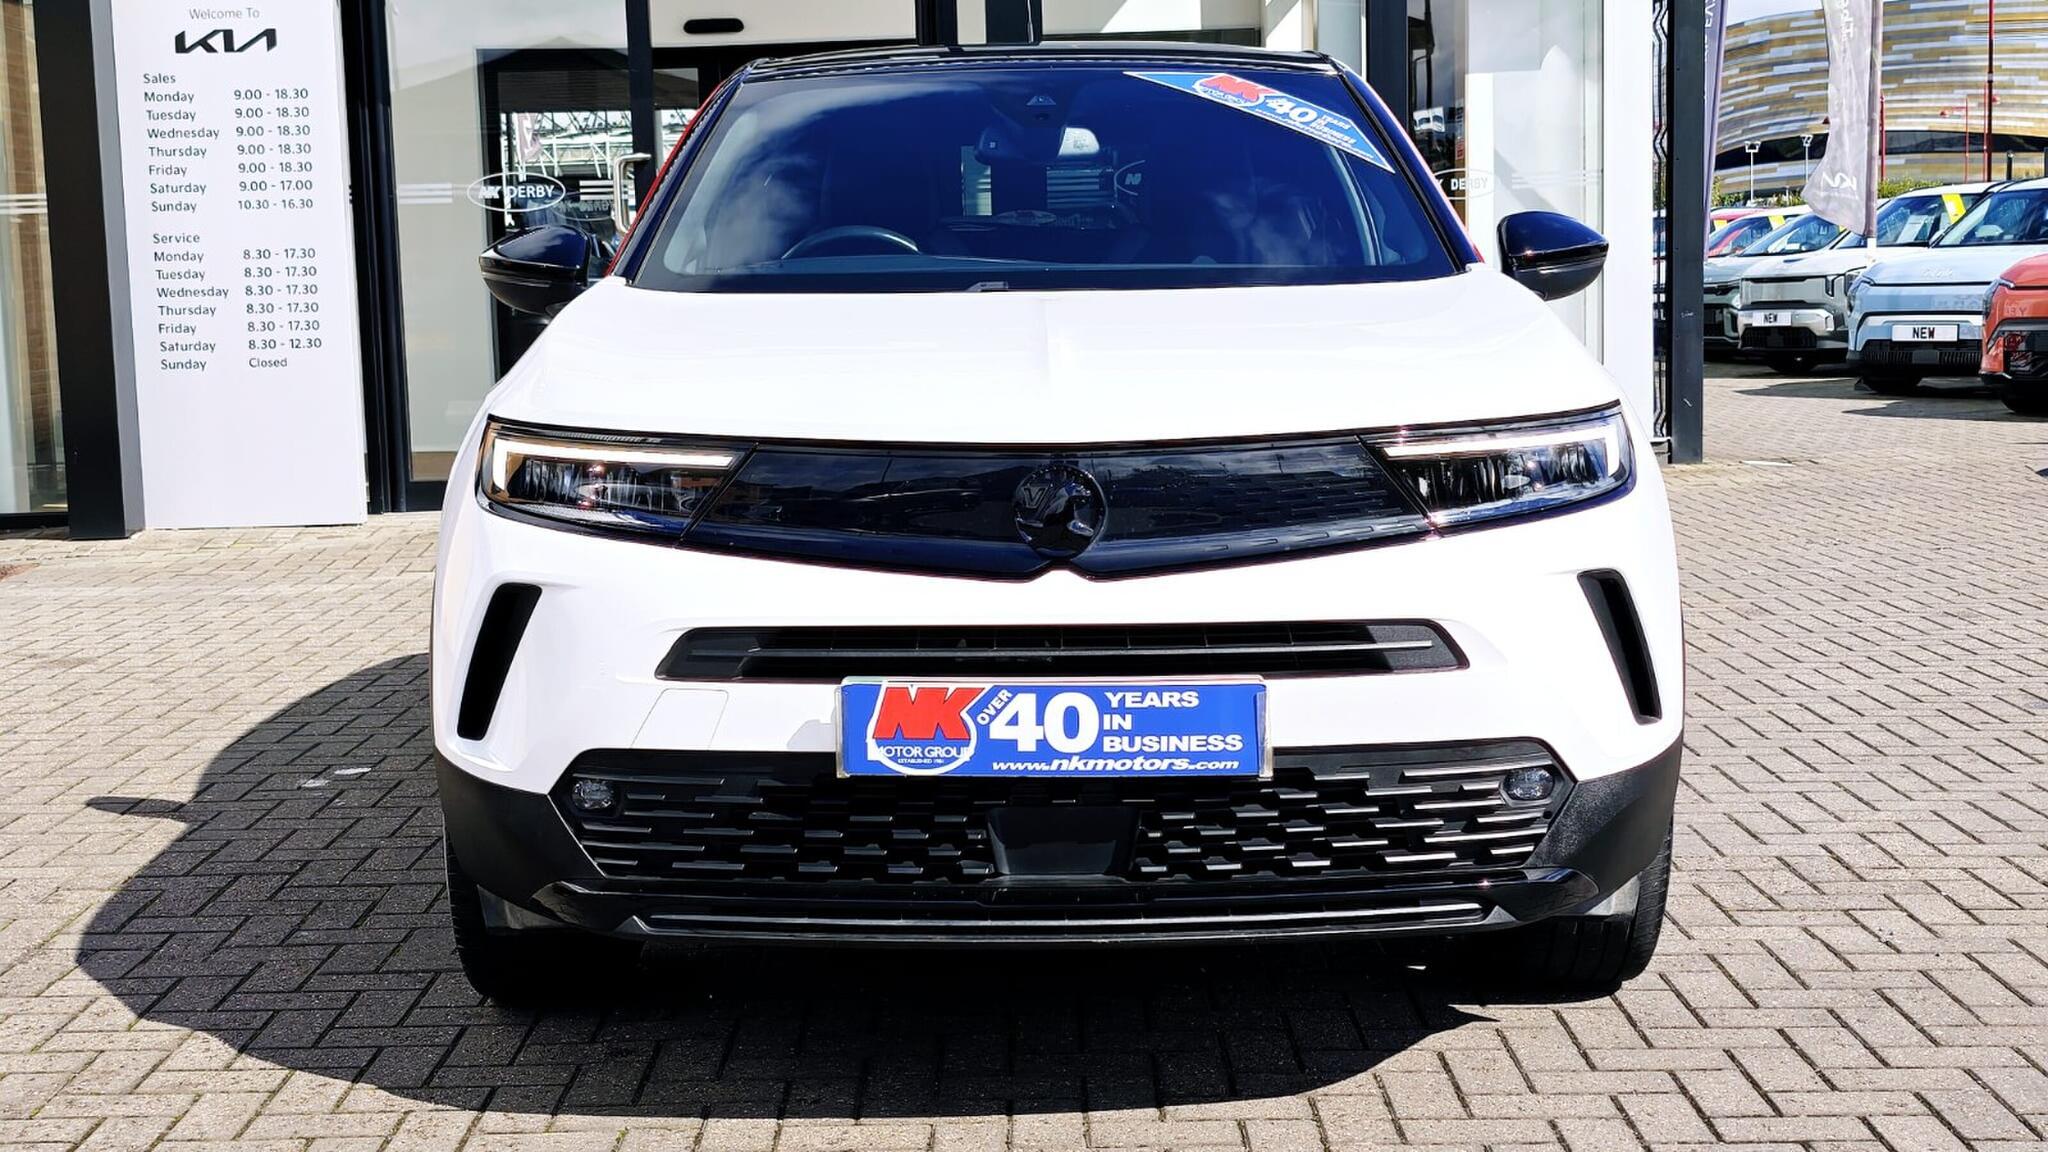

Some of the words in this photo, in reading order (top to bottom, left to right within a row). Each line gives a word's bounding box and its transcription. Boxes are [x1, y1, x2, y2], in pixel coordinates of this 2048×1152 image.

[189, 8, 242, 20] Welcome
[246, 8, 260, 18] To
[175, 28, 277, 54] KIA
[143, 73, 176, 84] Sales
[144, 91, 194, 103] Monday
[234, 89, 262, 100] 9.00
[275, 88, 308, 99] 18.30
[146, 110, 196, 122] Tuesday
[235, 108, 263, 118] 9.00
[276, 107, 309, 117] 18.30
[1266, 98, 1317, 122] 40
[147, 128, 219, 140] Wednesday
[236, 126, 264, 137] 9.00
[277, 125, 310, 136] 18.30
[148, 146, 207, 158] Thursday
[237, 144, 265, 155] 9.00
[278, 143, 311, 154] 18.30
[149, 165, 187, 177] Friday
[238, 162, 266, 173] 9.00
[279, 161, 312, 172] 18.30
[150, 183, 206, 195] Saturday
[239, 180, 267, 191] 9.00
[280, 180, 313, 191] 17.00
[478, 186, 502, 199] NK
[508, 185, 555, 198] DERBY
[151, 201, 197, 213] Sunday
[238, 199, 269, 210] 10.30
[282, 198, 313, 209] 16.30
[153, 233, 200, 244] Service
[154, 251, 204, 263] Monday
[243, 249, 271, 260] 8.30
[284, 248, 315, 259] 17.30
[155, 269, 205, 281] Tuesday
[244, 267, 272, 278] 8.30
[285, 266, 317, 277] 17.30
[156, 286, 229, 299] Wednesday
[245, 285, 273, 296] 8.30
[286, 284, 318, 295] 17.30
[157, 305, 217, 317] Thursday
[246, 303, 274, 314] 8.30
[287, 302, 319, 313] 17.30
[1763, 313, 1779, 324] NEW
[158, 323, 196, 336] Friday
[247, 321, 275, 332] 8.30
[288, 320, 320, 331] 17.30
[1912, 327, 1936, 339] NEW
[160, 341, 216, 353] Saturday
[248, 339, 276, 350] 8.30
[289, 338, 322, 349] 12.30
[161, 359, 207, 371] Sunday
[249, 357, 288, 368] Closed
[1104, 691, 1200, 708] YEARS
[872, 687, 986, 740] NK
[976, 689, 1014, 726] OVER
[989, 692, 1100, 754] 40
[1103, 714, 1132, 730] IN
[1103, 734, 1243, 752] BUSINESS
[992, 756, 1240, 771] www.nkmotors.com
